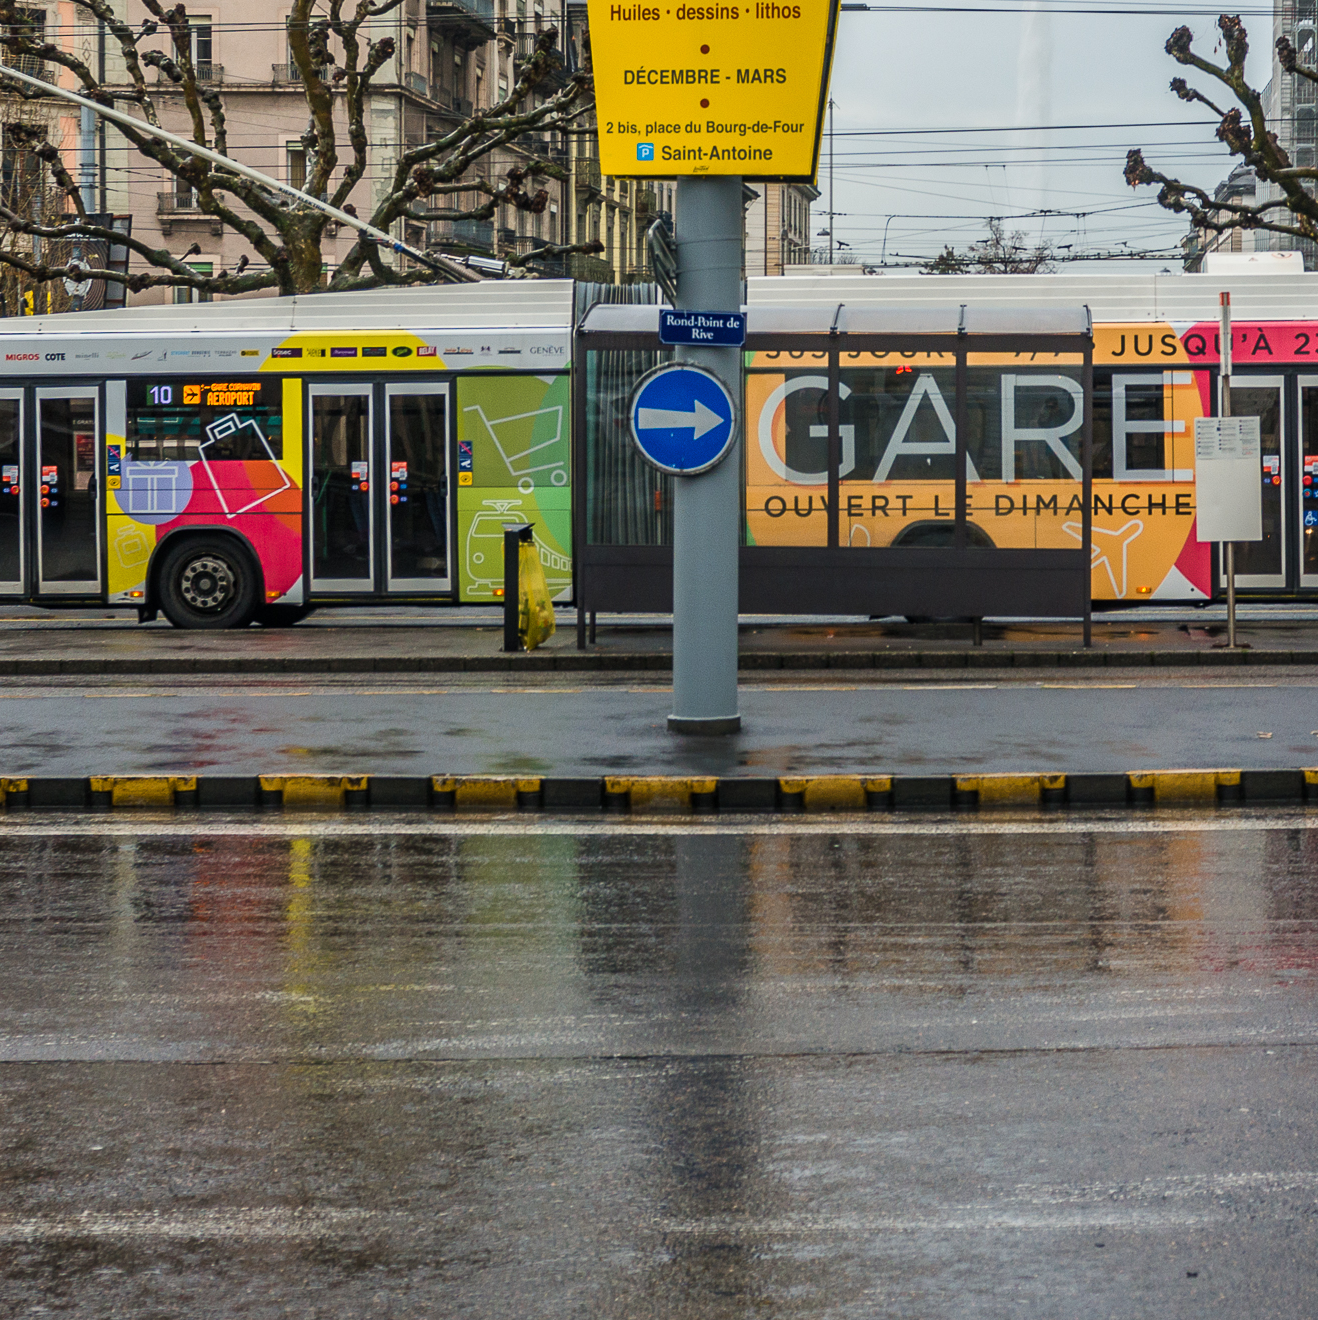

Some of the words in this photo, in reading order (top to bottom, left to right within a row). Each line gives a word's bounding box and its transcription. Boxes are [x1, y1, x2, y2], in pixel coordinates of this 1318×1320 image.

[610, 4, 660, 21] Huiles
[676, 3, 739, 20] dessins
[755, 2, 801, 20] lithos
[624, 66, 721, 85] DÉCEMBRE
[736, 68, 787, 84] MARS
[606, 122, 614, 134] 2
[618, 122, 641, 136] bis,
[645, 121, 681, 136] place
[685, 121, 701, 133] du
[706, 120, 804, 136] Bourg-de-Four
[661, 145, 773, 161] Saint-Antoine
[666, 314, 724, 328] Rond-Point
[726, 317, 740, 329] de
[691, 328, 714, 340] Rive
[5, 353, 40, 361] MIGROS
[45, 353, 66, 361] COTE
[149, 386, 172, 404] 10
[207, 392, 254, 405] AEROPORT
[758, 372, 1193, 485] GARE
[995, 493, 1192, 517] DIMANCHE
